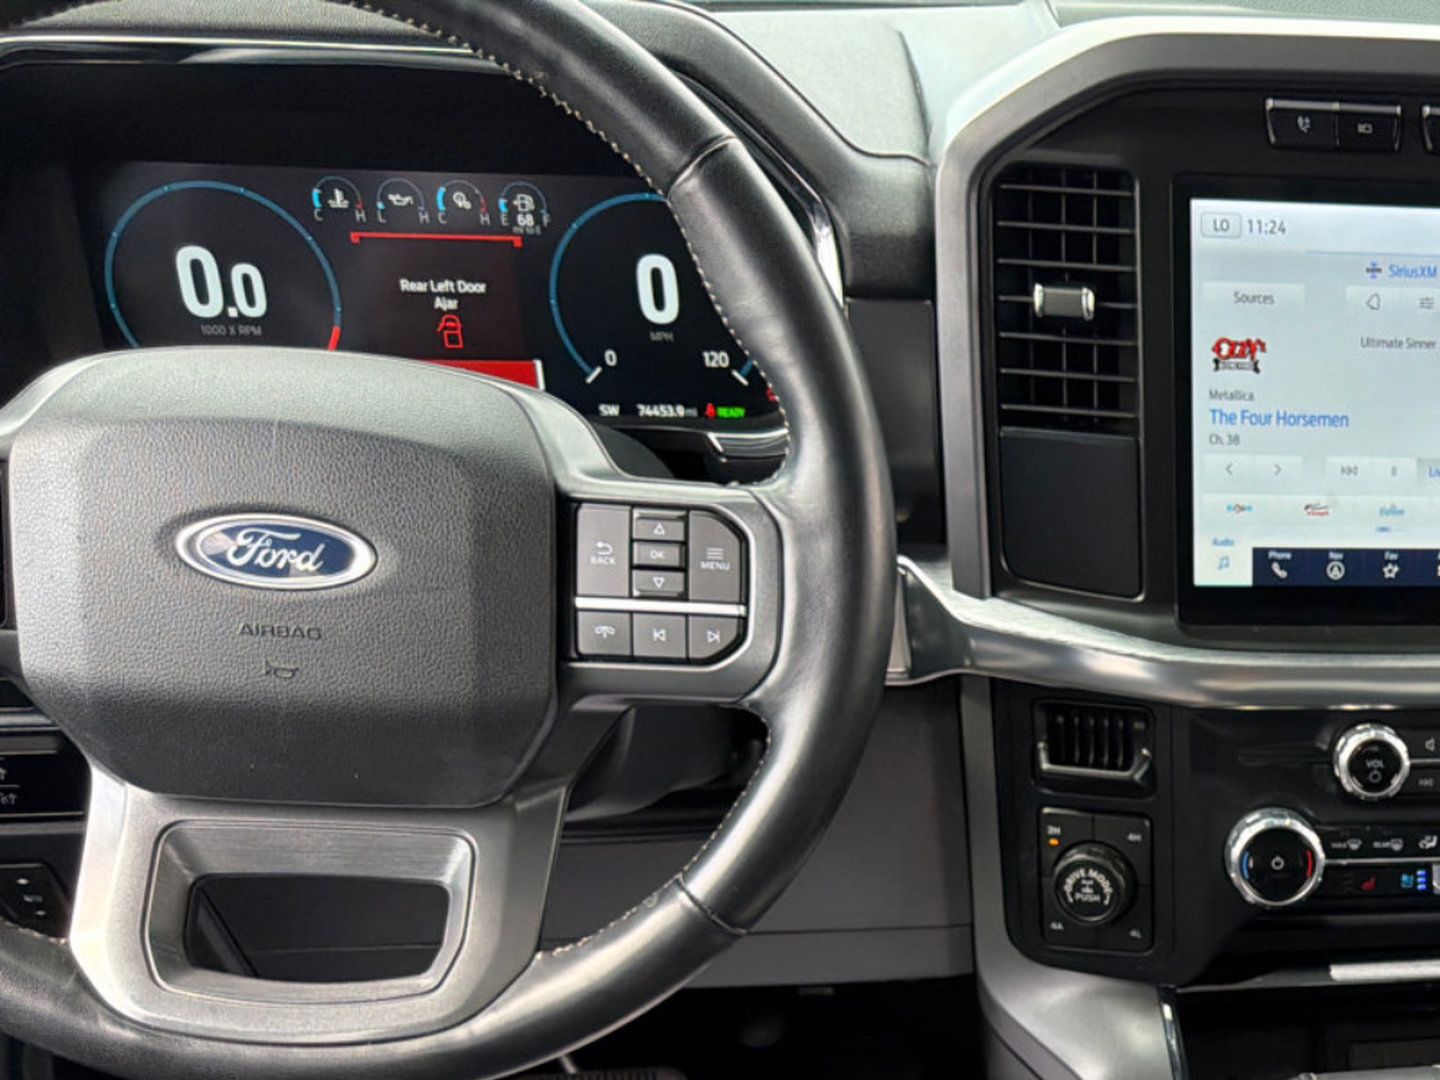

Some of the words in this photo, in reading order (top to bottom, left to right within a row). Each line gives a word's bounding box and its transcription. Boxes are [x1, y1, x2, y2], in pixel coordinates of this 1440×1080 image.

[517, 213, 533, 226] 68
[1213, 219, 1230, 232] LO
[1248, 219, 1286, 235] 11:24
[1388, 264, 1438, 279] SiriusXM
[176, 245, 267, 318] 0.0
[400, 278, 427, 293] Rear
[430, 279, 455, 293] Left
[457, 280, 486, 294] Door
[636, 254, 679, 325] 0
[434, 297, 458, 311] Ajar
[1234, 291, 1275, 305] Sources
[201, 325, 227, 336] 1000
[237, 325, 262, 336] RPM
[1361, 336, 1402, 349] Ultimate
[1405, 338, 1436, 350] Sinner
[604, 349, 617, 366] 0
[702, 352, 730, 367] 120
[1209, 390, 1254, 402] Metallica
[598, 404, 620, 416] SW
[717, 407, 746, 418] READY
[1209, 408, 1237, 426] The
[1240, 410, 1273, 427] Four
[1276, 411, 1350, 428] Horsemen
[1209, 434, 1225, 446] Ch.
[1227, 434, 1240, 446] 38
[226, 527, 326, 572] Ford
[650, 551, 664, 560] OK
[590, 556, 616, 565] BACK
[700, 560, 730, 571] MENU
[240, 623, 323, 640] AIRBAG
[1365, 760, 1384, 769] VOL
[1064, 867, 1086, 892] DRIVE
[1088, 867, 1113, 893] MODE
[1074, 892, 1100, 902] PUSH
